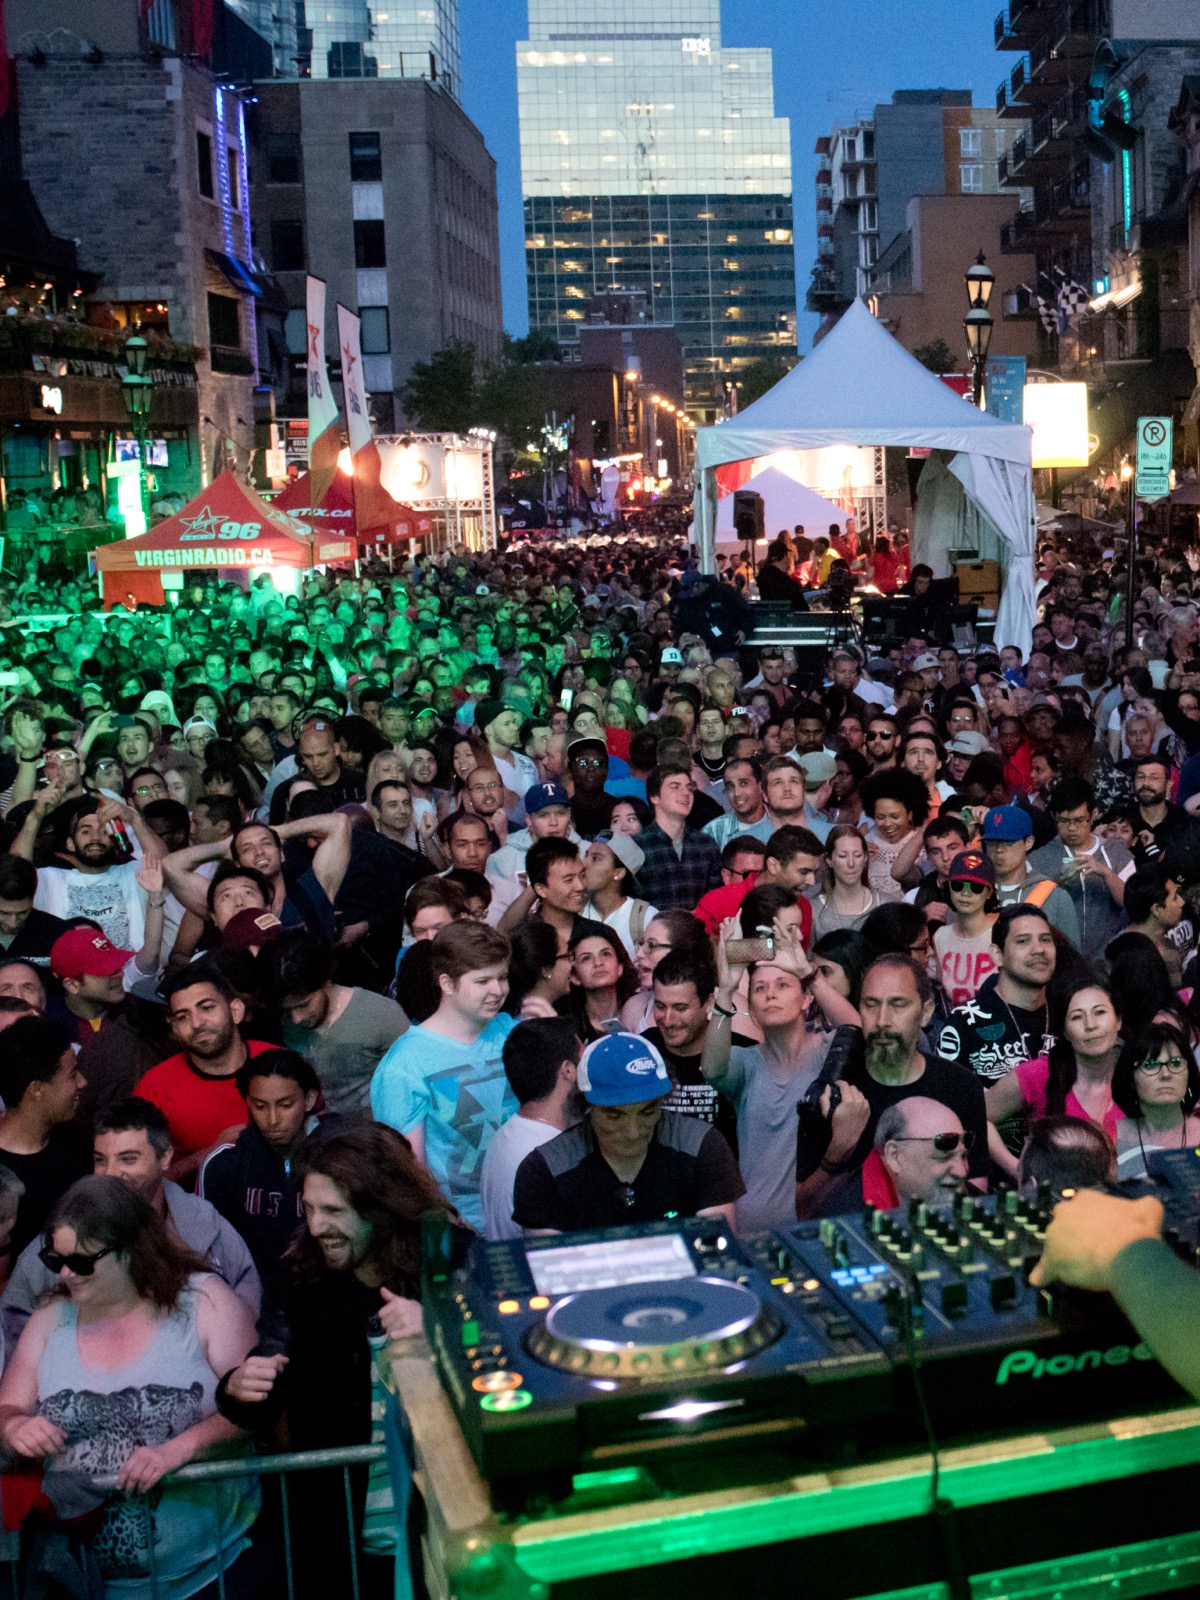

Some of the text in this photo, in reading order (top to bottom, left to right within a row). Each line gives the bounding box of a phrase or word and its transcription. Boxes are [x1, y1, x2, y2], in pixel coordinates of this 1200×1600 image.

[682, 38, 711, 51] IBM
[218, 521, 262, 540] 96
[134, 548, 274, 566] VIRGINRADIO.CA
[542, 783, 556, 796] T
[996, 1341, 1156, 1385] Pionee
